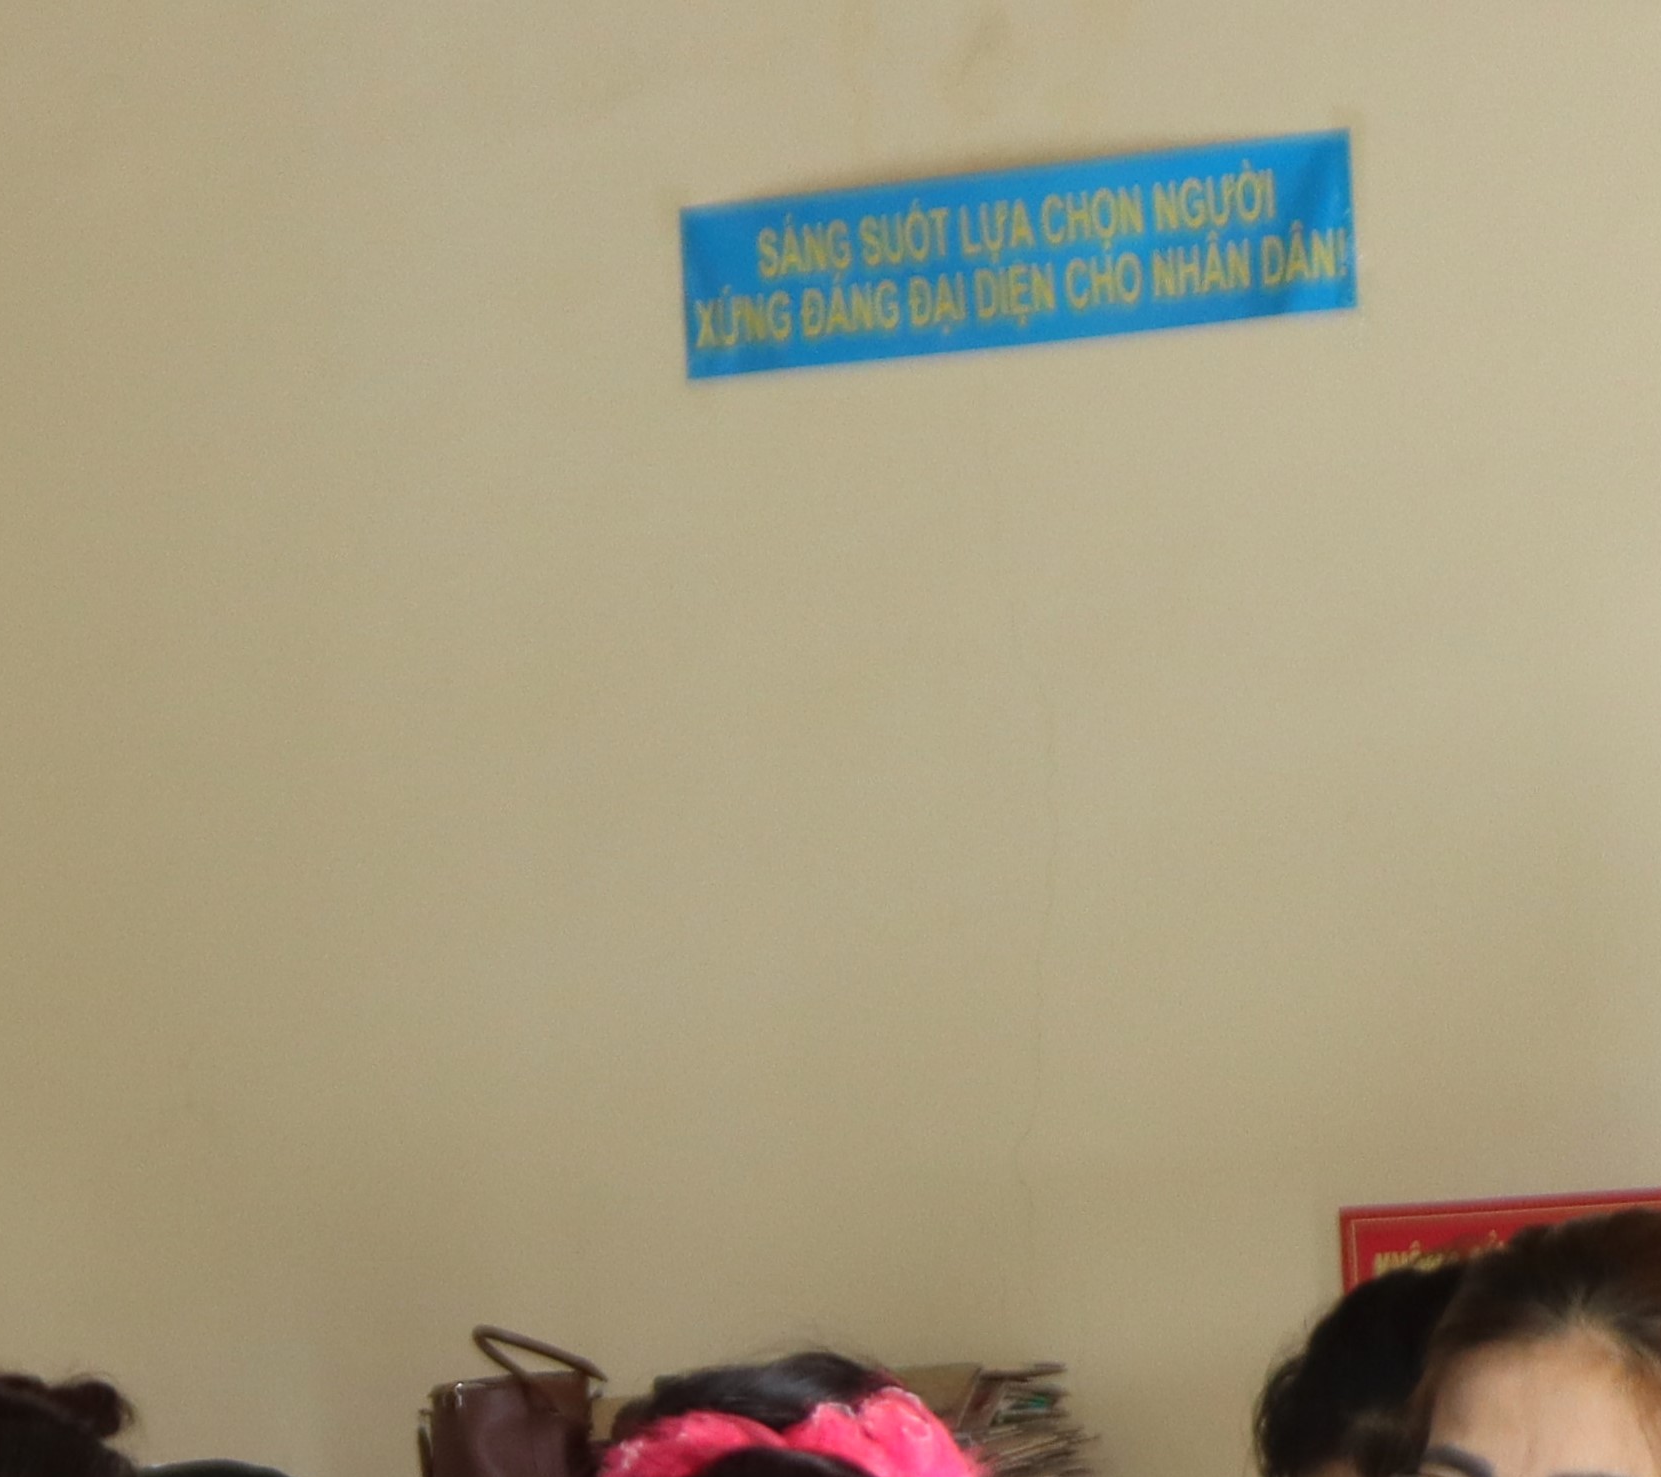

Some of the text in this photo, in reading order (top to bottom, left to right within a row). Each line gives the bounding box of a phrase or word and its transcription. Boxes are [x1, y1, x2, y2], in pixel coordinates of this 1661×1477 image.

[758, 212, 852, 278] SÁNG
[960, 197, 1035, 264] LỰA
[1041, 185, 1143, 250] CHỌN
[1152, 158, 1275, 231] NGƯỜI
[800, 270, 901, 339] ĐÁNG
[908, 270, 966, 335] ĐẠI
[975, 260, 1057, 328] DIỆN
[1064, 251, 1142, 312] CHO
[1151, 230, 1252, 298] NHÂN
